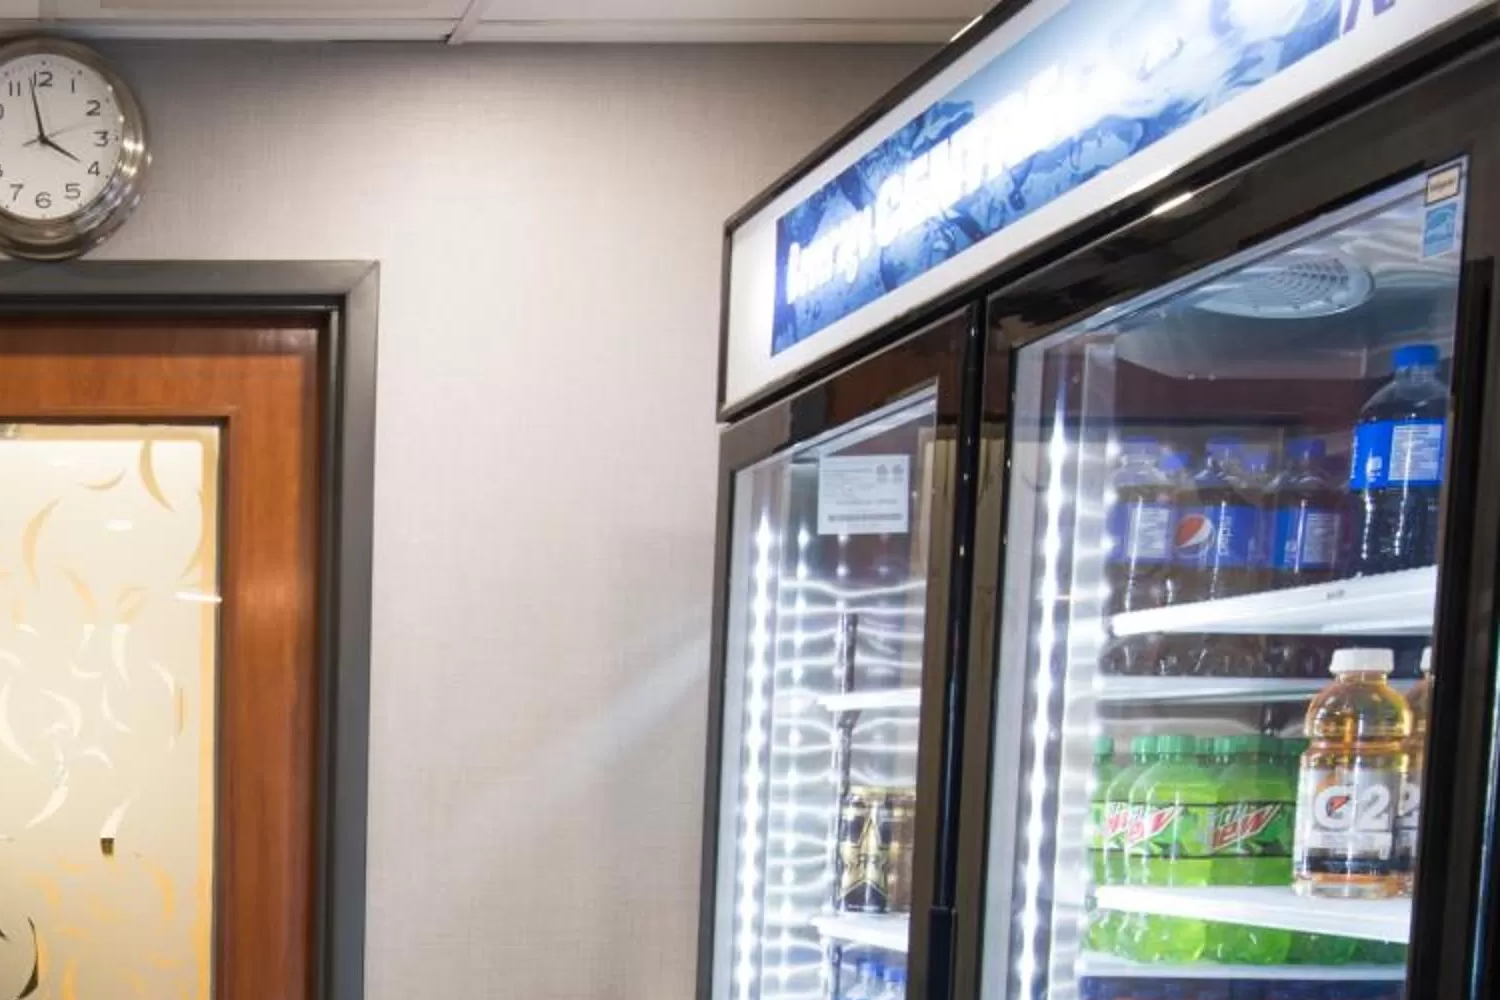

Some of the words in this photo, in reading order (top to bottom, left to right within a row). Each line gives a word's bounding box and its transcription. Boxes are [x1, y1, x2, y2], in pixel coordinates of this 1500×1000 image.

[33, 71, 54, 88] 12
[8, 80, 22, 97] 11
[85, 100, 102, 117] 2
[94, 131, 109, 147] 3
[87, 161, 101, 176] 4
[9, 183, 24, 201] 7
[65, 183, 81, 199] 5
[35, 192, 52, 208] 6
